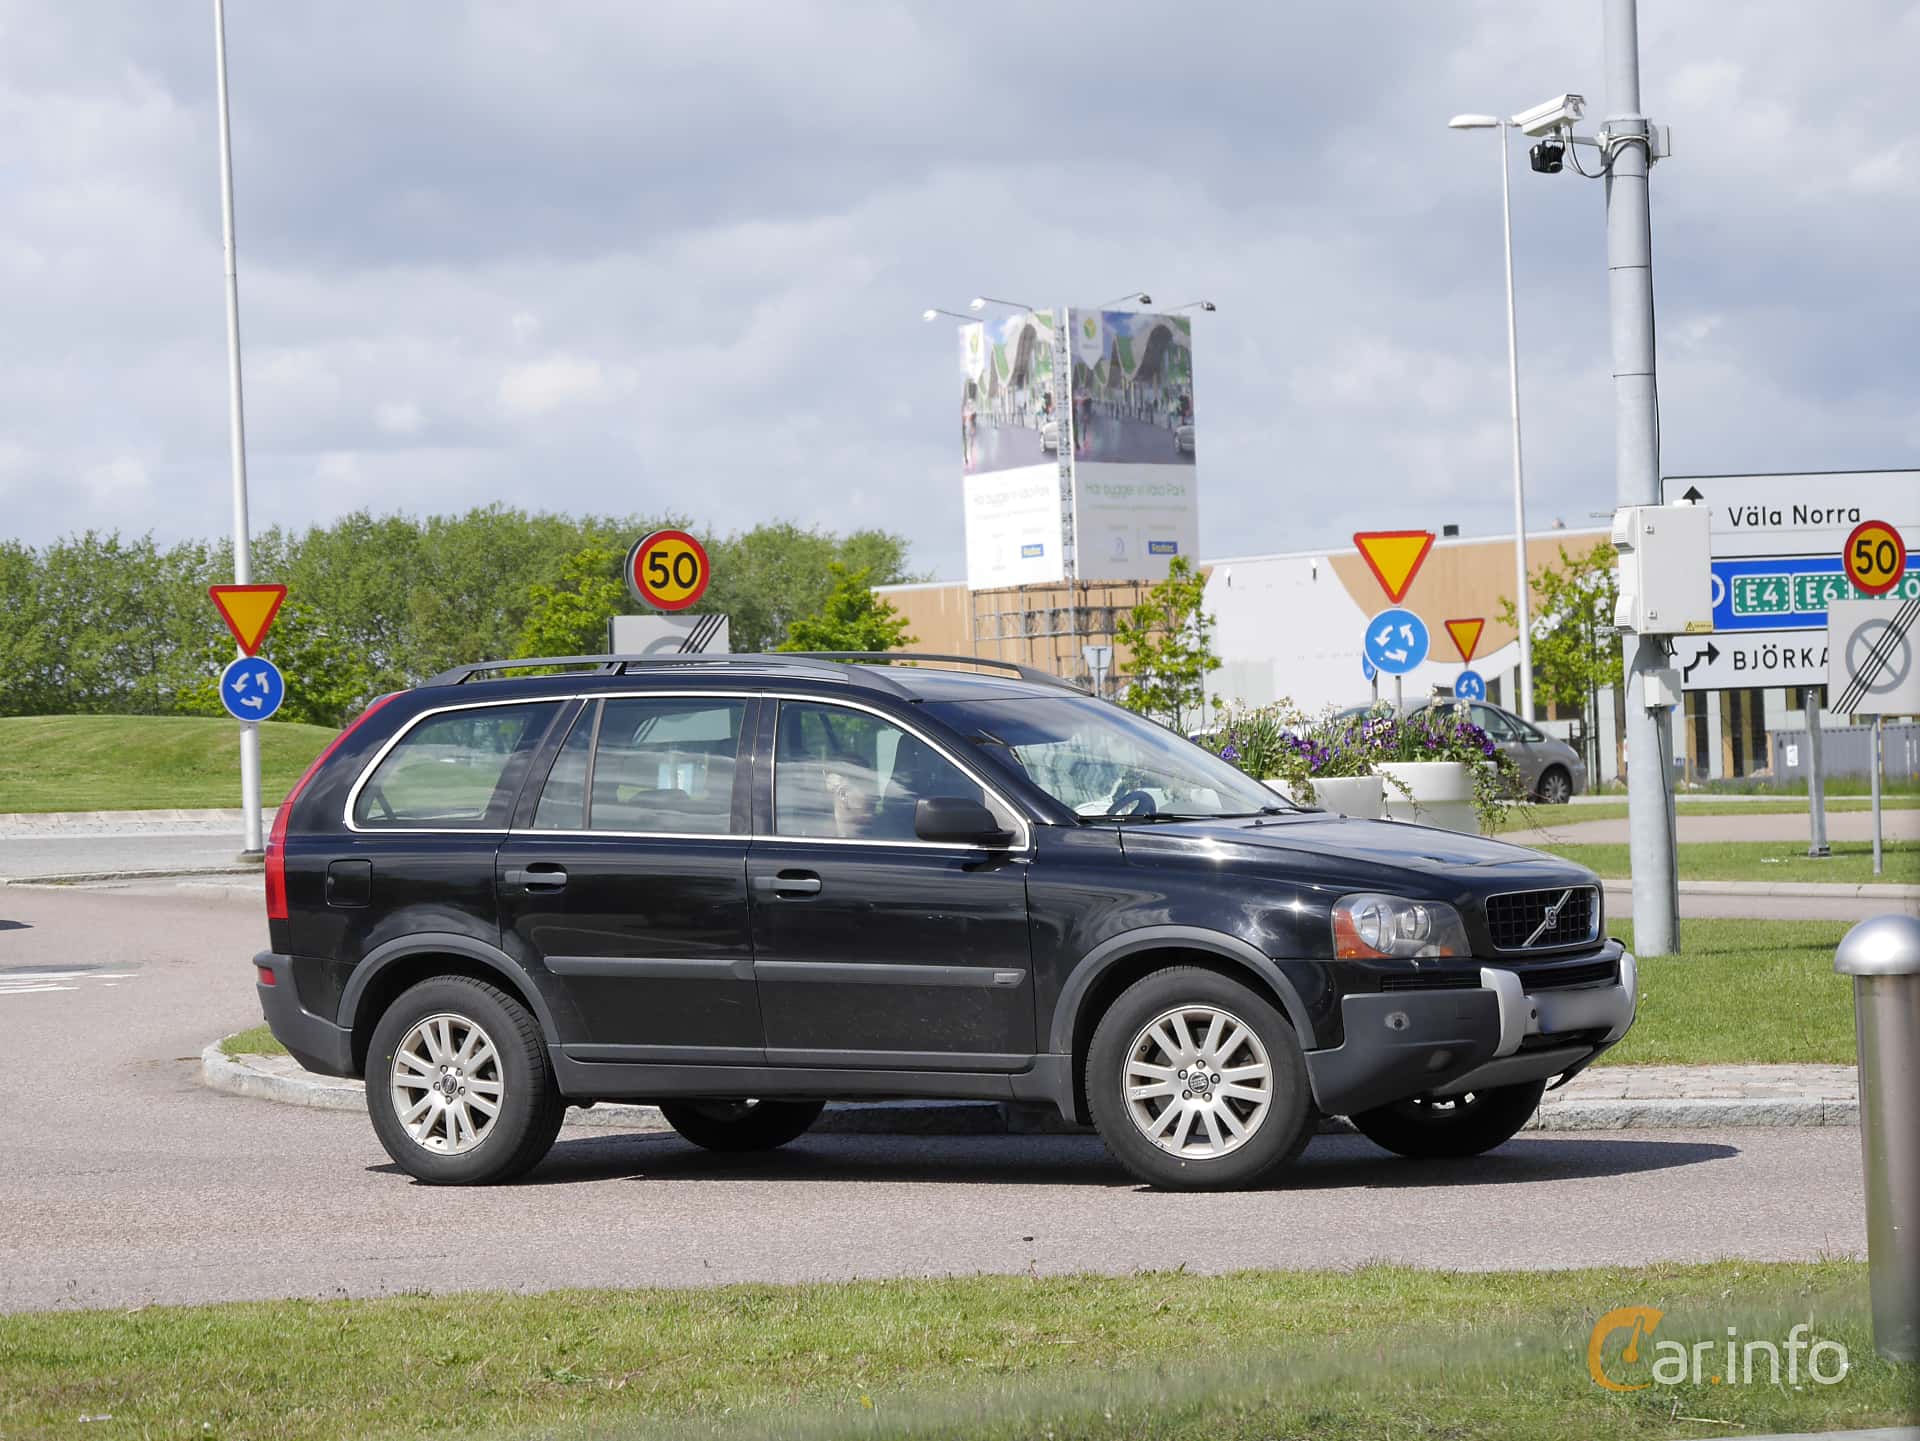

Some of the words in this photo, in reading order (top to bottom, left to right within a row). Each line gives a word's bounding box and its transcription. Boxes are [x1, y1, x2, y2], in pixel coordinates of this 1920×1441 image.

[1728, 506, 1782, 527] Väla
[1793, 504, 1861, 524] Norra
[649, 551, 698, 589] 50
[1856, 540, 1897, 575] 50
[1746, 583, 1779, 606] E4
[1806, 581, 1838, 604] E6
